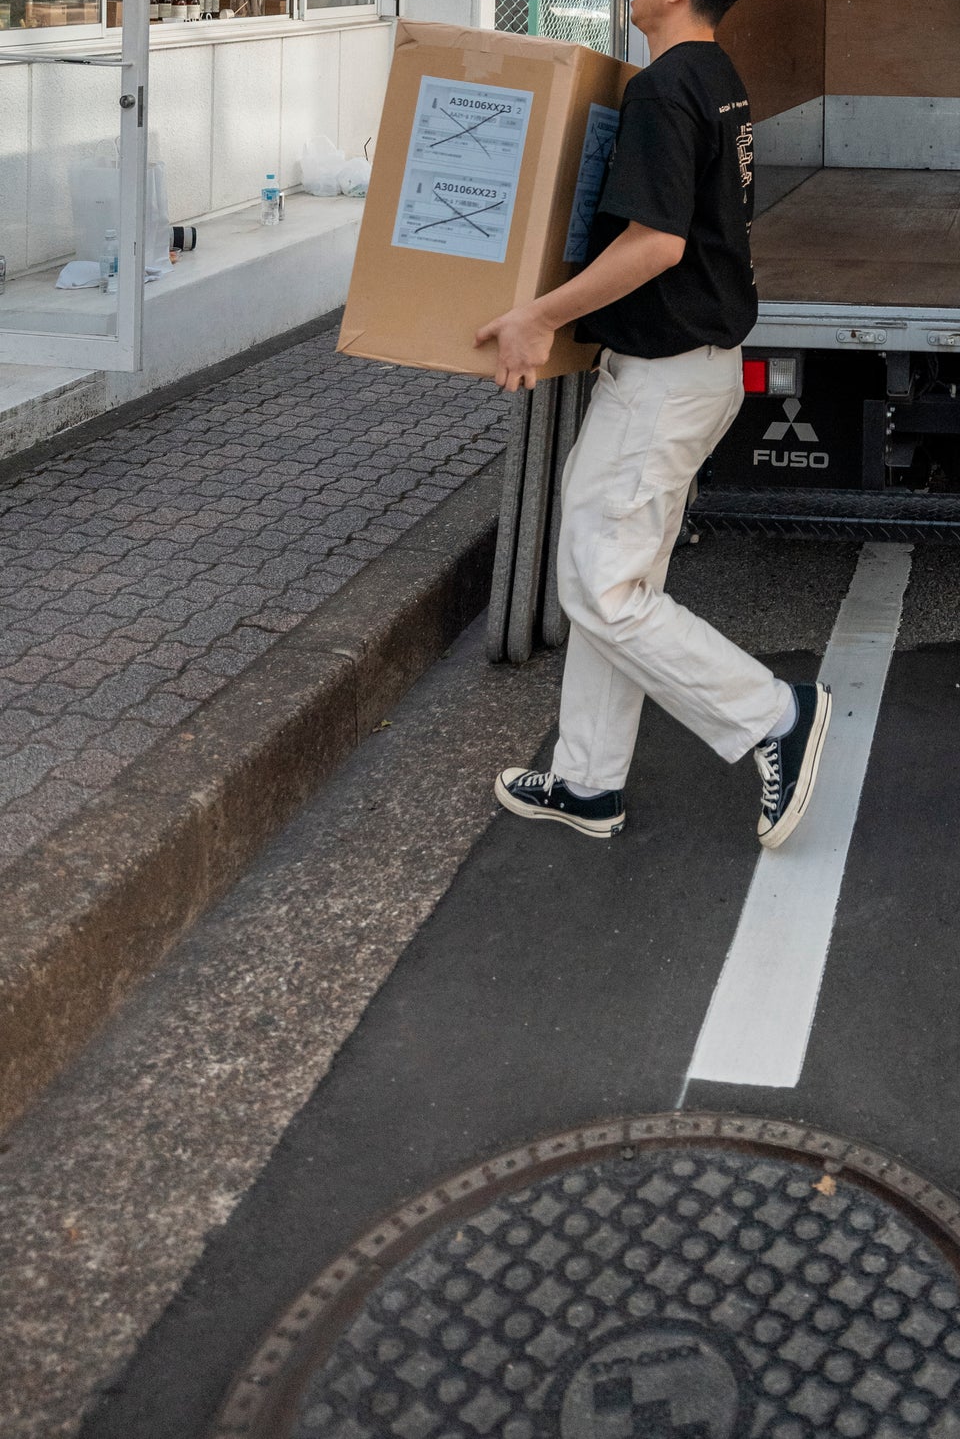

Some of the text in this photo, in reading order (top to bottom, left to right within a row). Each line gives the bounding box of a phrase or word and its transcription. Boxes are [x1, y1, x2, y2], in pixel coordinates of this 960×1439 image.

[449, 97, 512, 113] A30106XX23
[434, 182, 497, 198] A30106XX23
[502, 192, 507, 200] 3
[753, 449, 830, 469] FUSO
